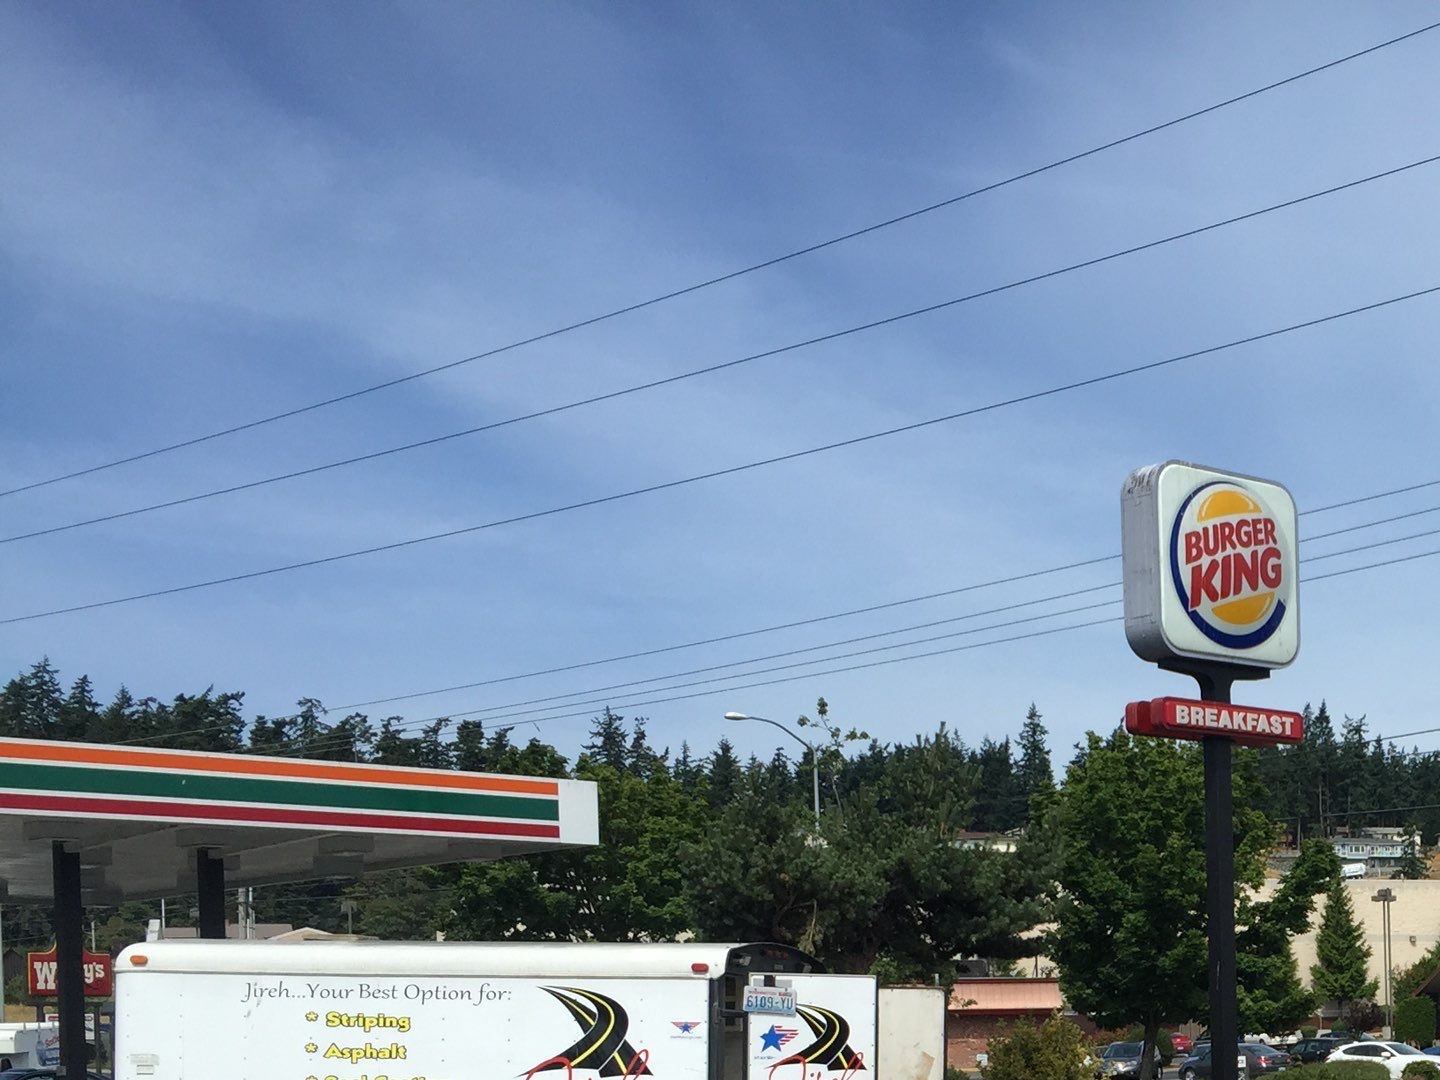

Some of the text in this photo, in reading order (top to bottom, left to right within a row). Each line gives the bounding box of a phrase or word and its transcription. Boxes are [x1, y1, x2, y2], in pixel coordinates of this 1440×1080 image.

[1184, 517, 1278, 565] BURGER
[1188, 547, 1282, 612] KING
[1175, 704, 1294, 736] BREAKFAST
[33, 961, 105, 990] Wy's
[358, 983, 397, 1001] Best
[403, 984, 472, 1005] Option
[472, 983, 512, 1006] for:
[325, 1011, 411, 1032] Striping
[323, 1043, 407, 1064] Asphalt
